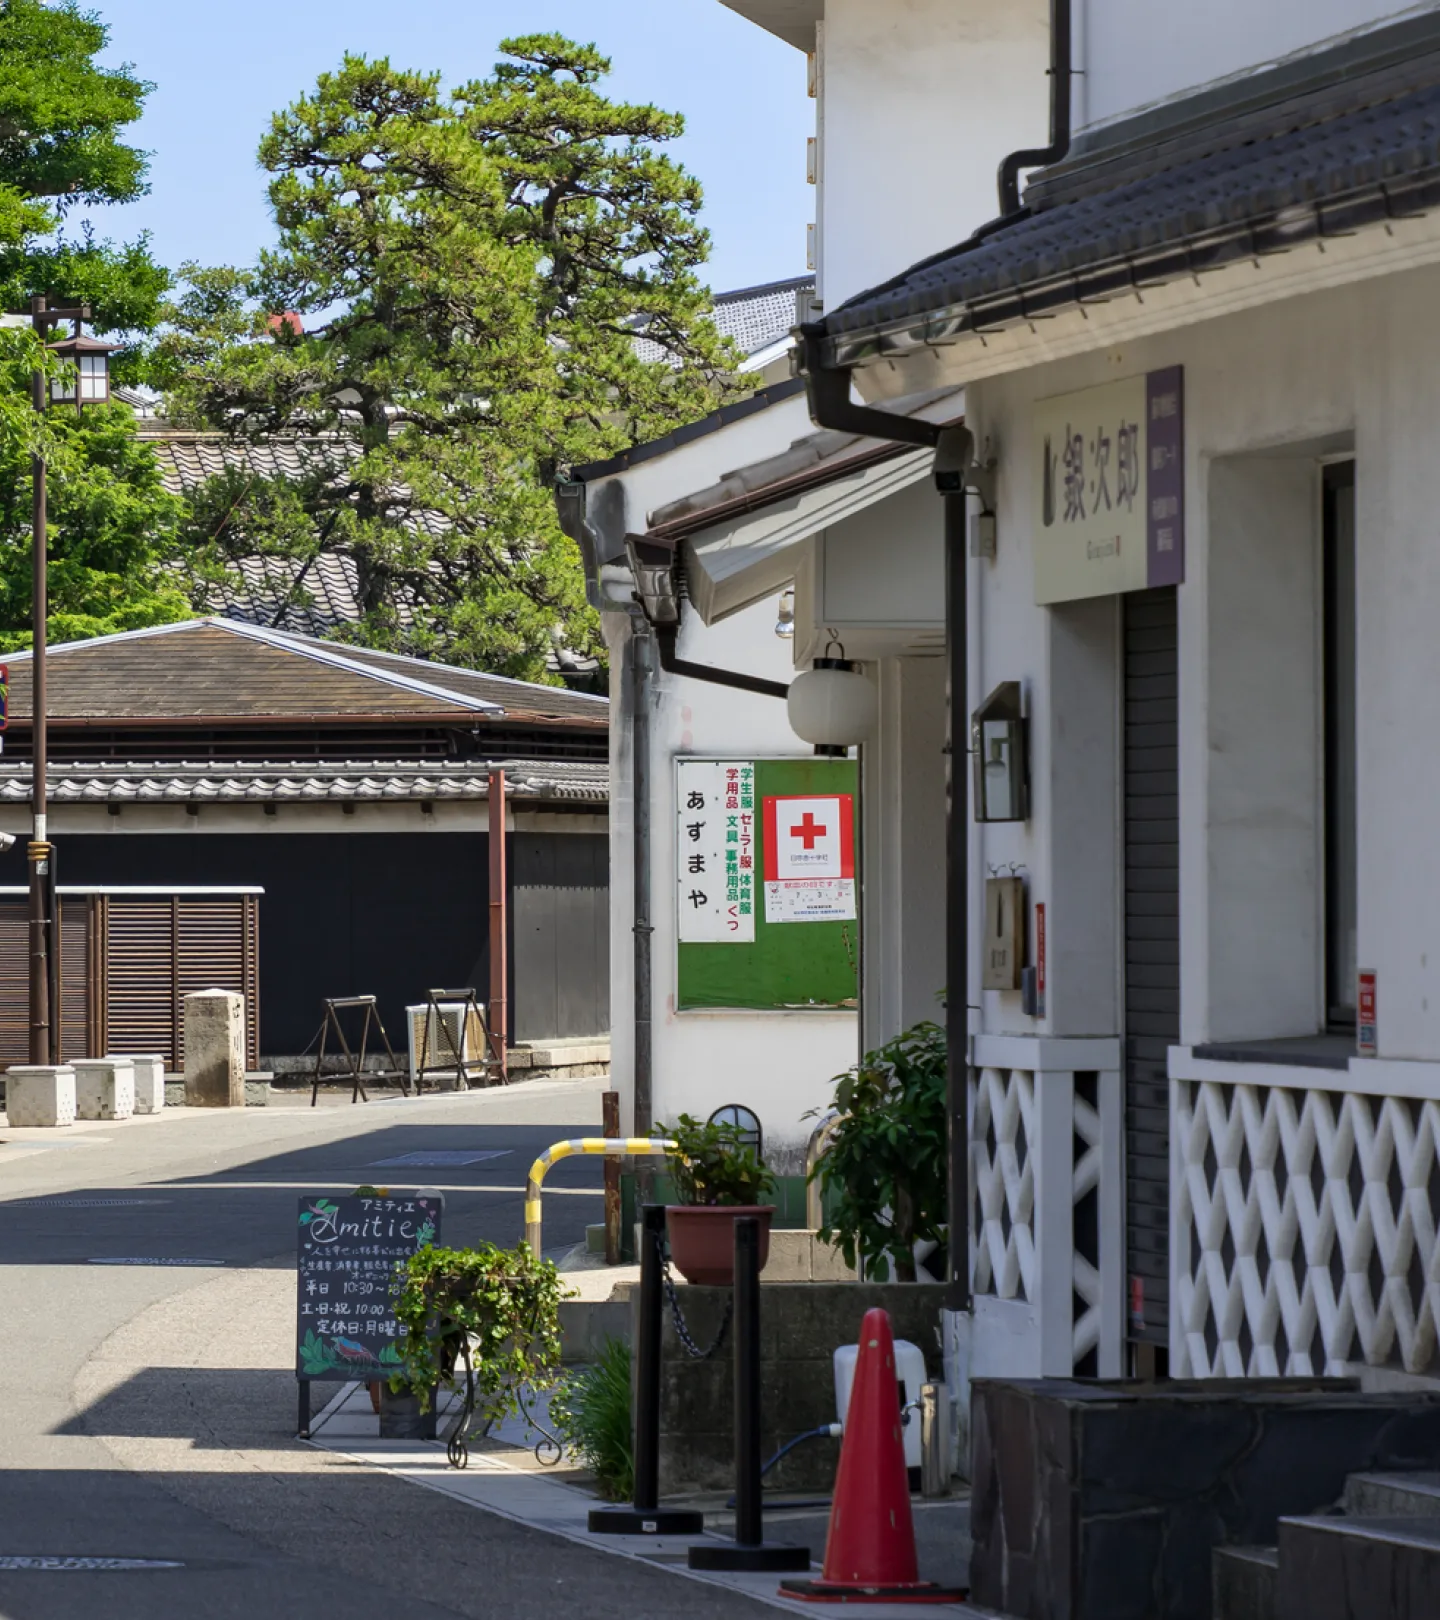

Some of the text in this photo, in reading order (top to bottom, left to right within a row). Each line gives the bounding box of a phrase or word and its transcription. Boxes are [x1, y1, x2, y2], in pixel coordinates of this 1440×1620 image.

[725, 768, 739, 931] 学用品 文具 事務用品 くつ
[739, 768, 753, 915] 学生服 セーラー服 体育服
[361, 1199, 415, 1212] アミティエ
[310, 1207, 416, 1243] Amitie
[305, 1279, 329, 1296] 平日
